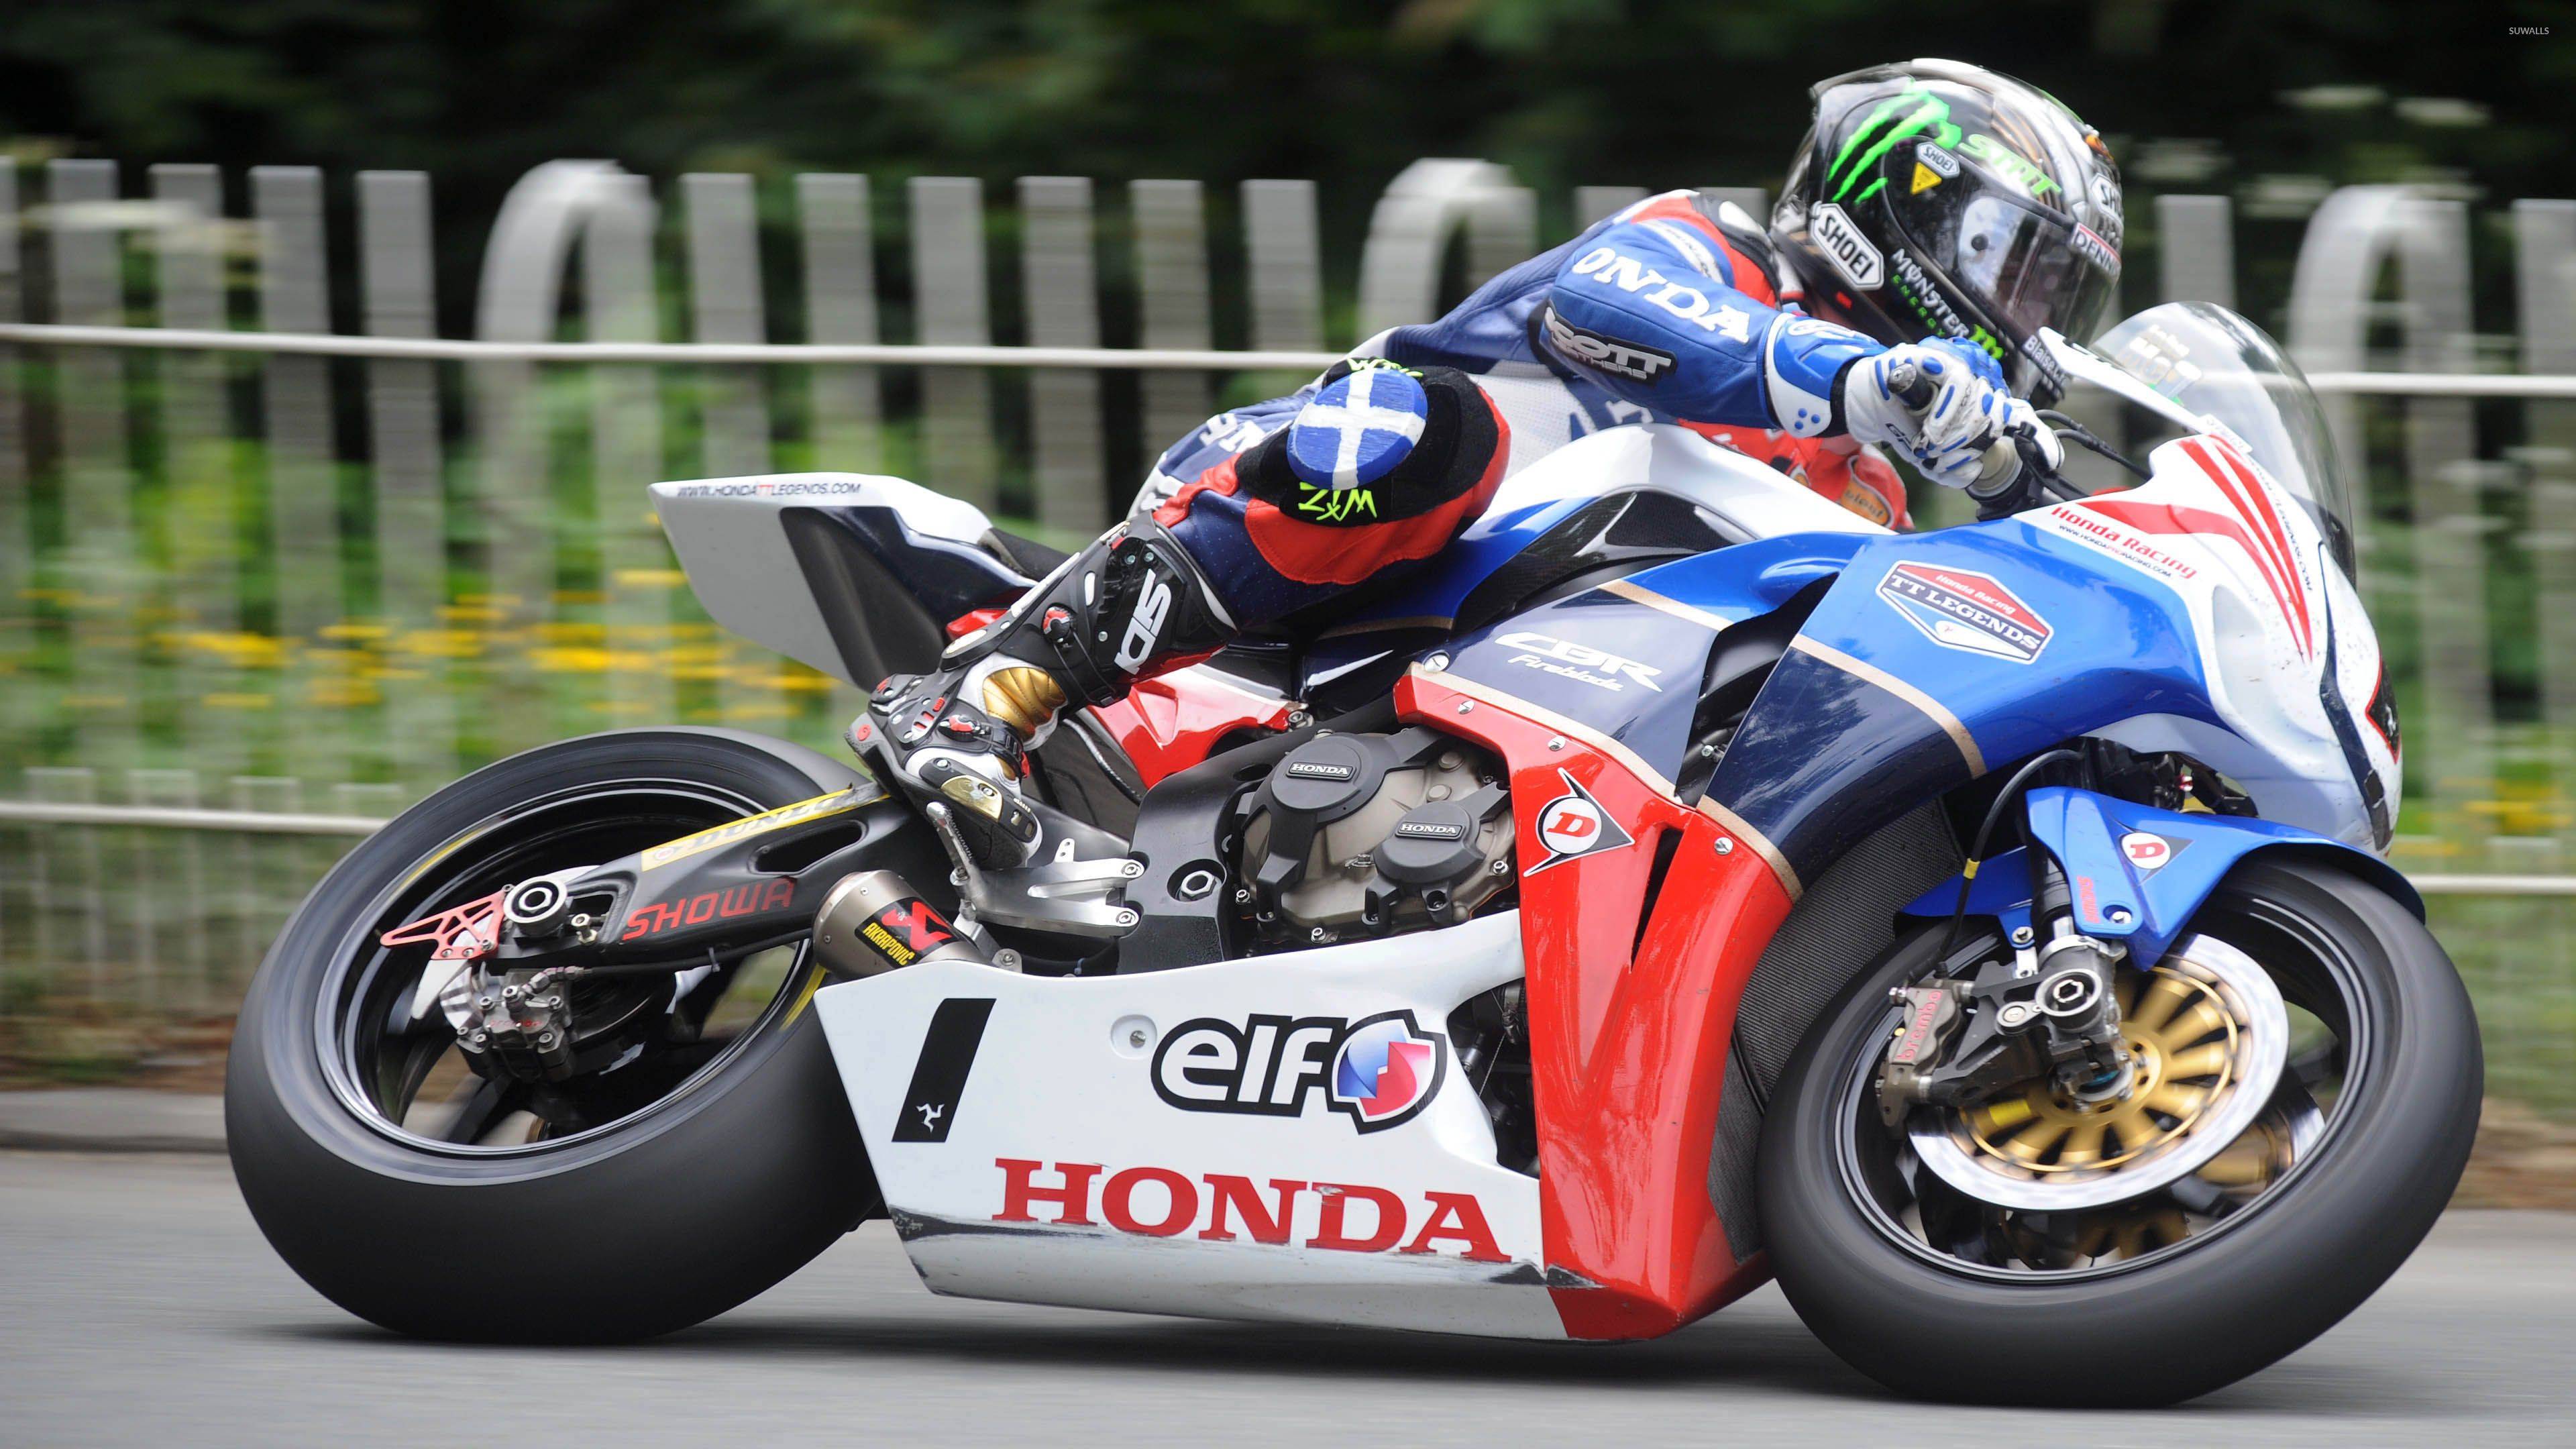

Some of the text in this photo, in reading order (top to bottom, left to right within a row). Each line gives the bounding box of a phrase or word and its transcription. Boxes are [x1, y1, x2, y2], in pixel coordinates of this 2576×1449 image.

[1923, 146, 1955, 172] SHOEI
[1819, 213, 1875, 279] SHOEI
[1890, 248, 1970, 337] MONSTER
[1544, 307, 1672, 374] SCOTT
[2051, 506, 2197, 580] Honda Racing
[1890, 574, 2041, 650] TT LEGENDS
[1935, 574, 2017, 615] Honda Racing
[1495, 632, 1663, 692] CBR
[1291, 763, 1348, 775] HONDA
[1401, 822, 1456, 834] HONDA
[1546, 812, 1597, 838] D
[2130, 842, 2165, 859] D
[621, 877, 796, 941] SHOWA
[1896, 990, 1943, 1060] brembo
[1161, 1022, 1332, 1106] elf
[992, 1157, 1511, 1263] HONDA
